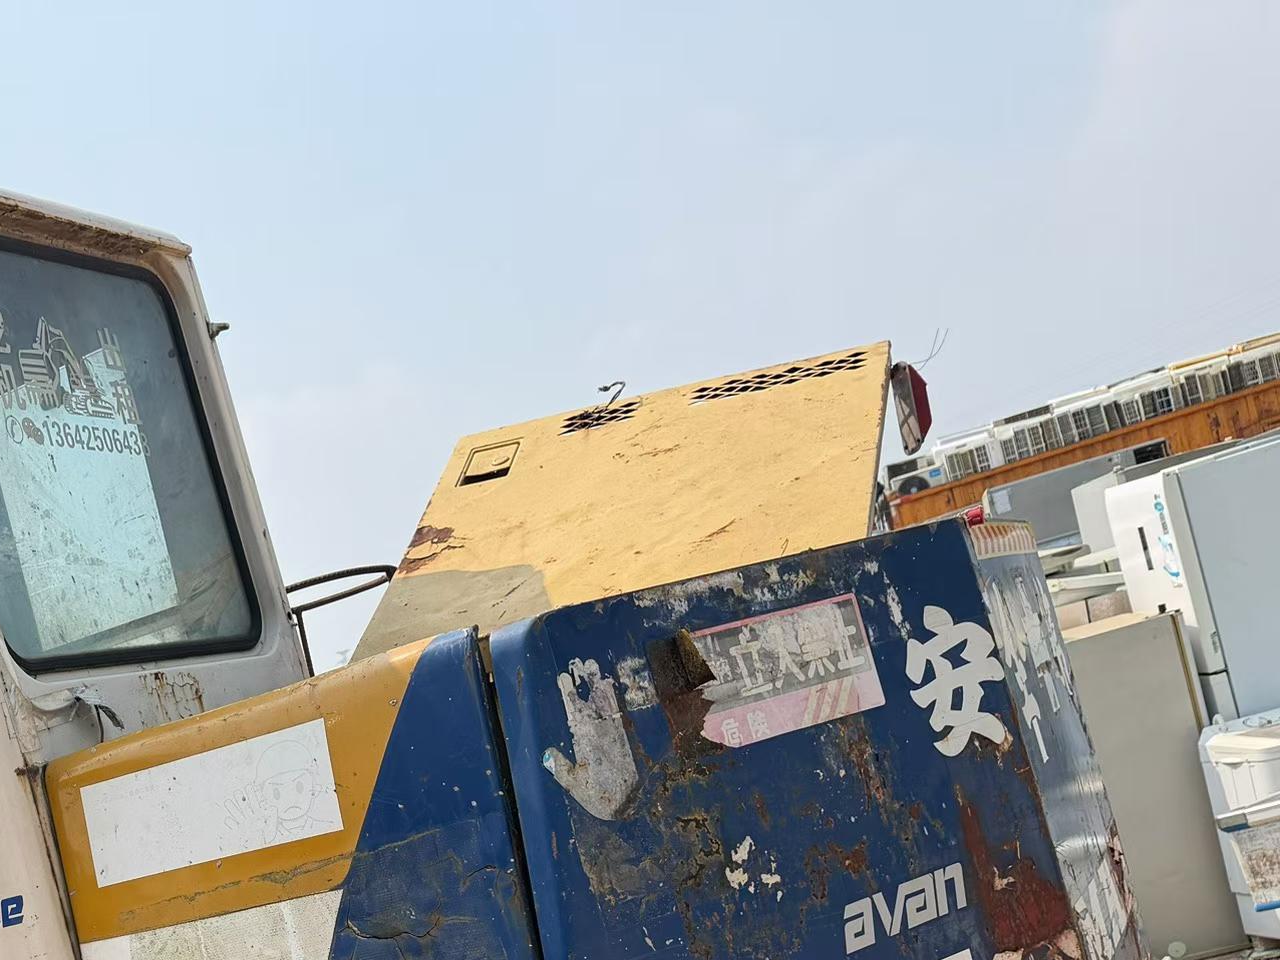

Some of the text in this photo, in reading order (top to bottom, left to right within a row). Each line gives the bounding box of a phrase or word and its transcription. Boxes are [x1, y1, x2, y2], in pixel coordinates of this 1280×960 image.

[96, 327, 143, 425] 出租
[41, 419, 151, 457] 13642506438
[905, 605, 1006, 757] 安
[842, 861, 969, 956] avan
